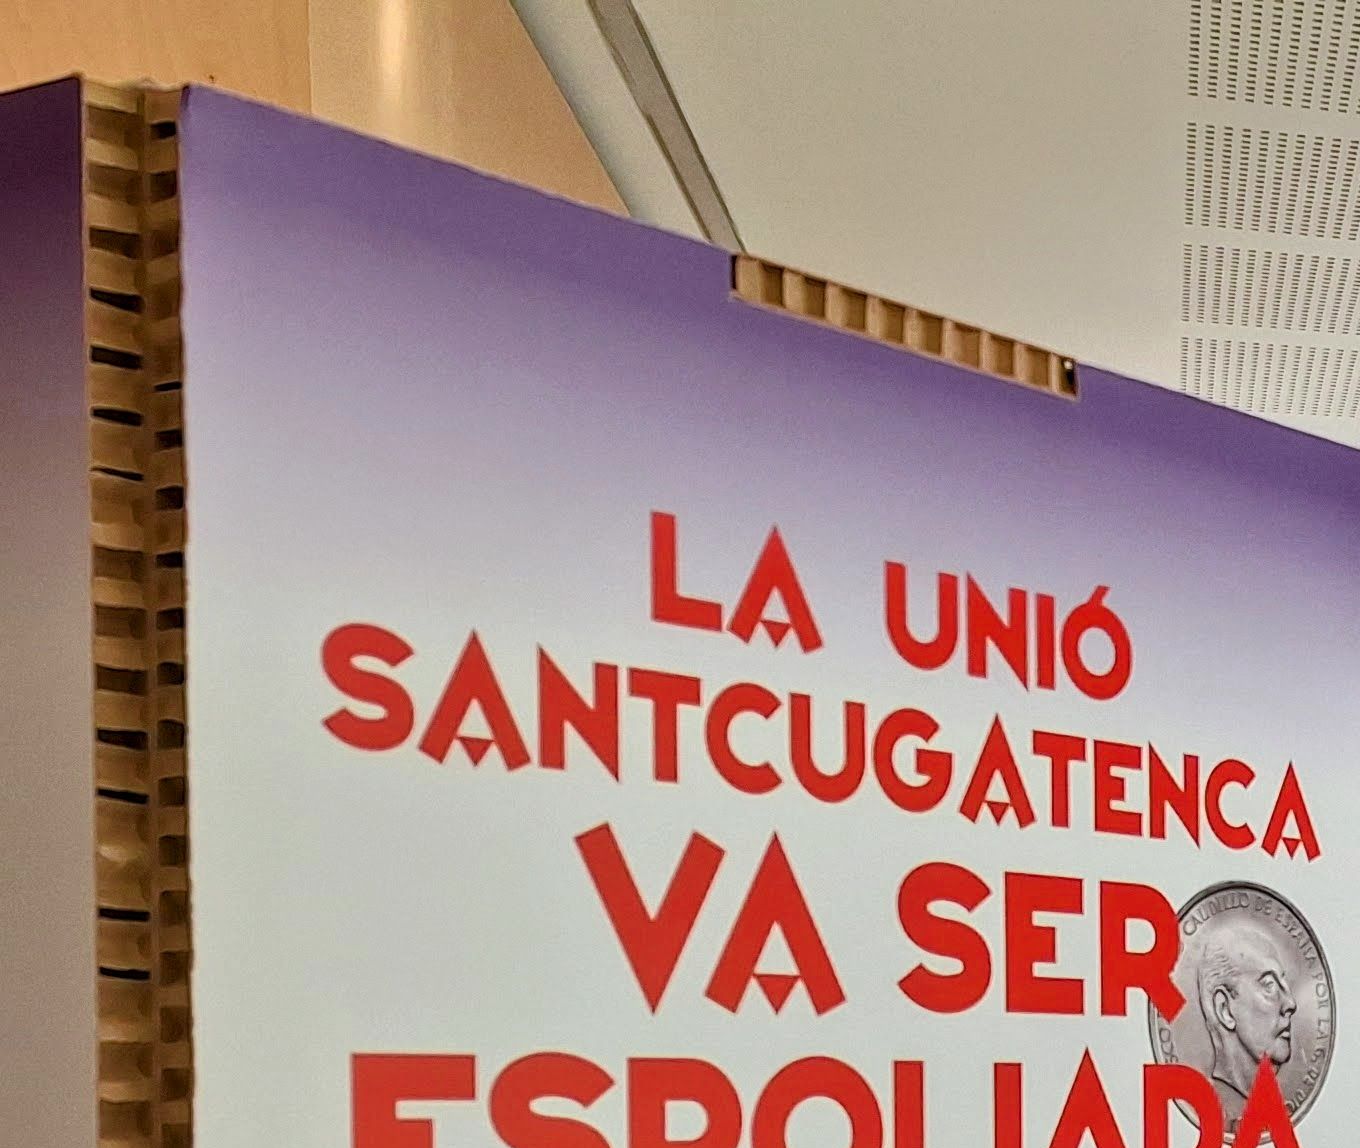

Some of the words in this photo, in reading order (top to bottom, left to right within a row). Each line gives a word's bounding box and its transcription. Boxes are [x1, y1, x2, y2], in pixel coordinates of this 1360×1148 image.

[649, 511, 824, 651] LA
[884, 561, 1133, 701] UNIÓ
[321, 623, 1322, 862] SANTCUGATENCA
[574, 823, 847, 1016] VA
[895, 861, 1187, 1021] SER
